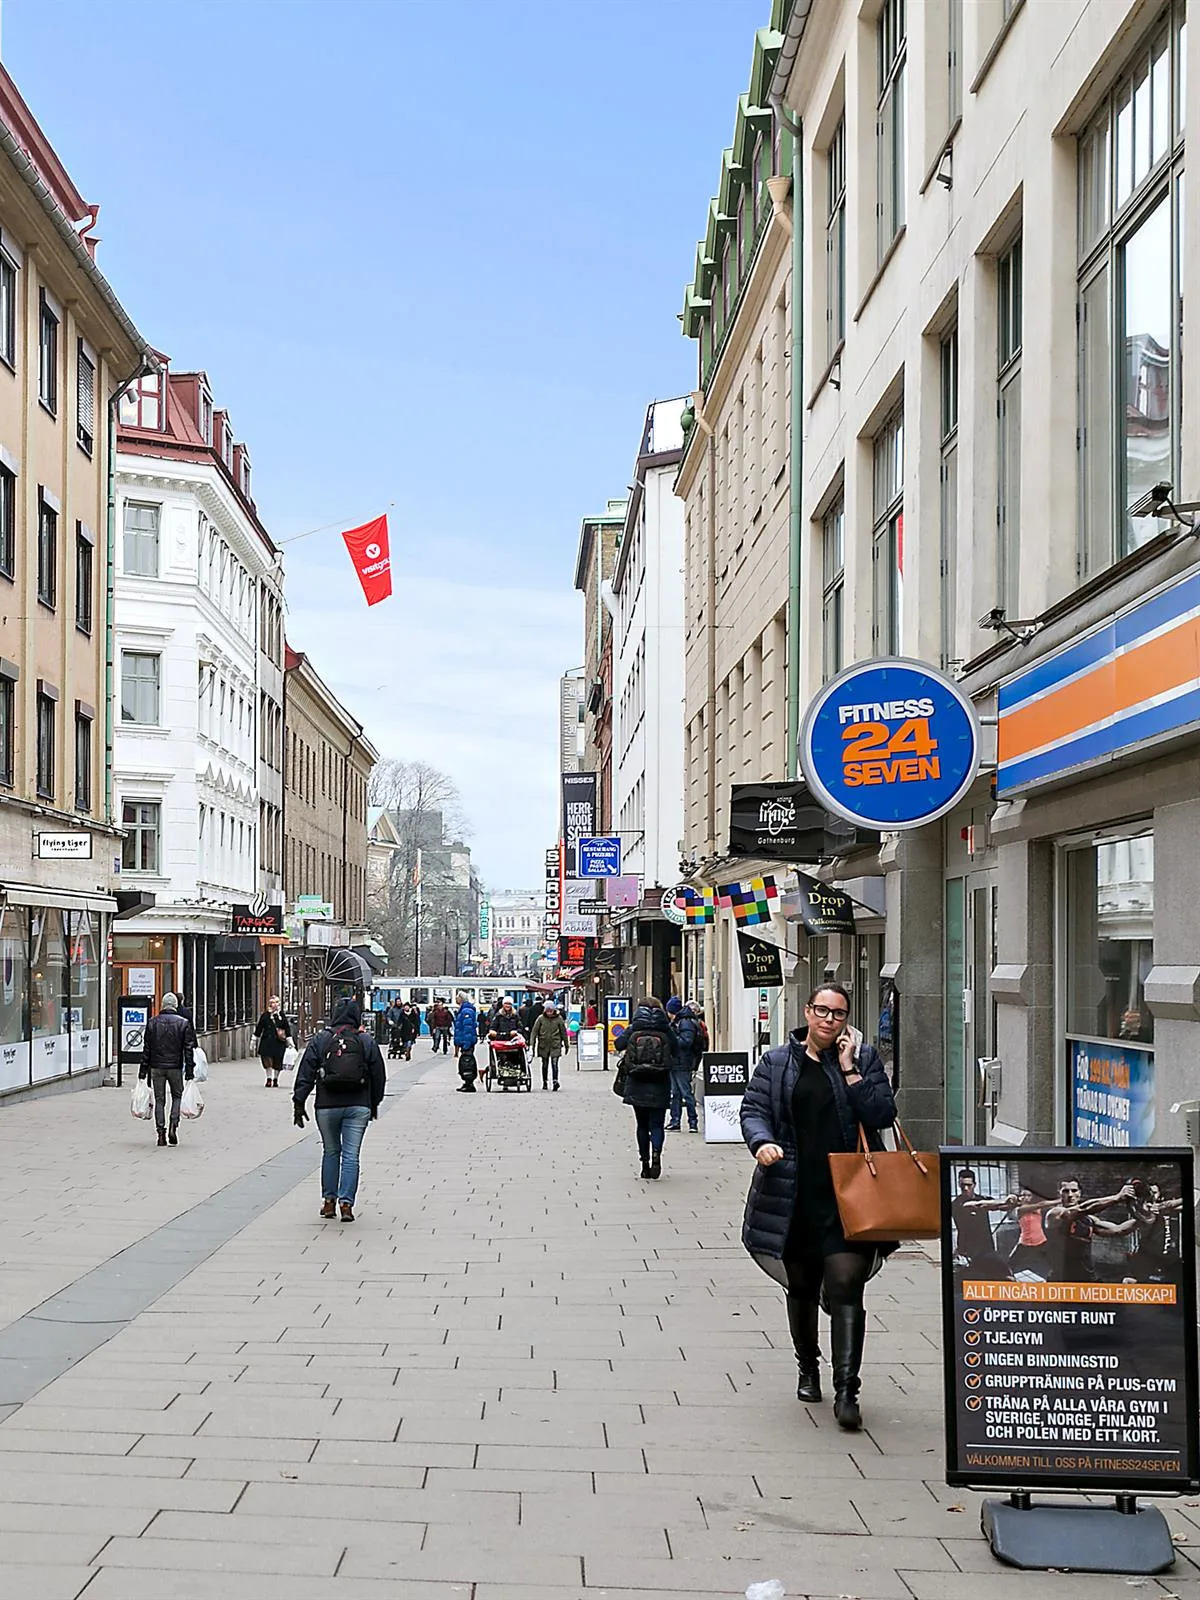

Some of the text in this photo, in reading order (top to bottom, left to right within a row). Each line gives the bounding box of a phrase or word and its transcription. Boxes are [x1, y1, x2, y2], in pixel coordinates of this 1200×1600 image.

[839, 698, 935, 724] FITNESS
[841, 717, 938, 763] 24
[843, 756, 940, 786] SEVEN
[564, 777, 594, 785] NISSES
[567, 802, 594, 815] HERR-
[567, 814, 593, 826] MODE
[567, 826, 592, 841] SOM
[43, 839, 87, 848] flying tiger
[807, 892, 846, 907] Drop
[821, 904, 836, 916] in
[746, 953, 775, 964] Drop
[756, 963, 768, 973] in
[709, 1064, 744, 1075] DEDIC
[1076, 1049, 1089, 1081] FÖR
[1076, 1084, 1130, 1122] TRÄNA DU DYGNET
[1076, 1115, 1130, 1147] RUNT PÅ ALLA VÅRA
[965, 1285, 995, 1299] ALLT
[999, 1284, 1037, 1299] INGÅR
[1049, 1287, 1076, 1300] DITT
[1080, 1287, 1173, 1302] MEDLEMSKAP!
[983, 1307, 1116, 1325] ÖPPET DYGNET RUNT
[983, 1331, 1043, 1345] TJEJGYM
[984, 1352, 1119, 1369] INGEN BINDNINGSTID
[985, 1373, 1176, 1392] GRUPPTRÄNING PÅ PLUS-GYM
[985, 1396, 1029, 1410] TRÄNA
[1033, 1395, 1050, 1411] PÅ
[1053, 1397, 1087, 1412] ALLA
[1090, 1395, 1125, 1412] VÅRA
[1129, 1400, 1159, 1413] GYM
[985, 1412, 1156, 1429] SVERIGE, NORGE, FINLAND
[986, 1425, 1160, 1443] OCH POLEN MED ETT KORT.
[966, 1453, 1181, 1472] VÄLKOMMEN TILL OSS PÅ FITNESS24SEVEN
